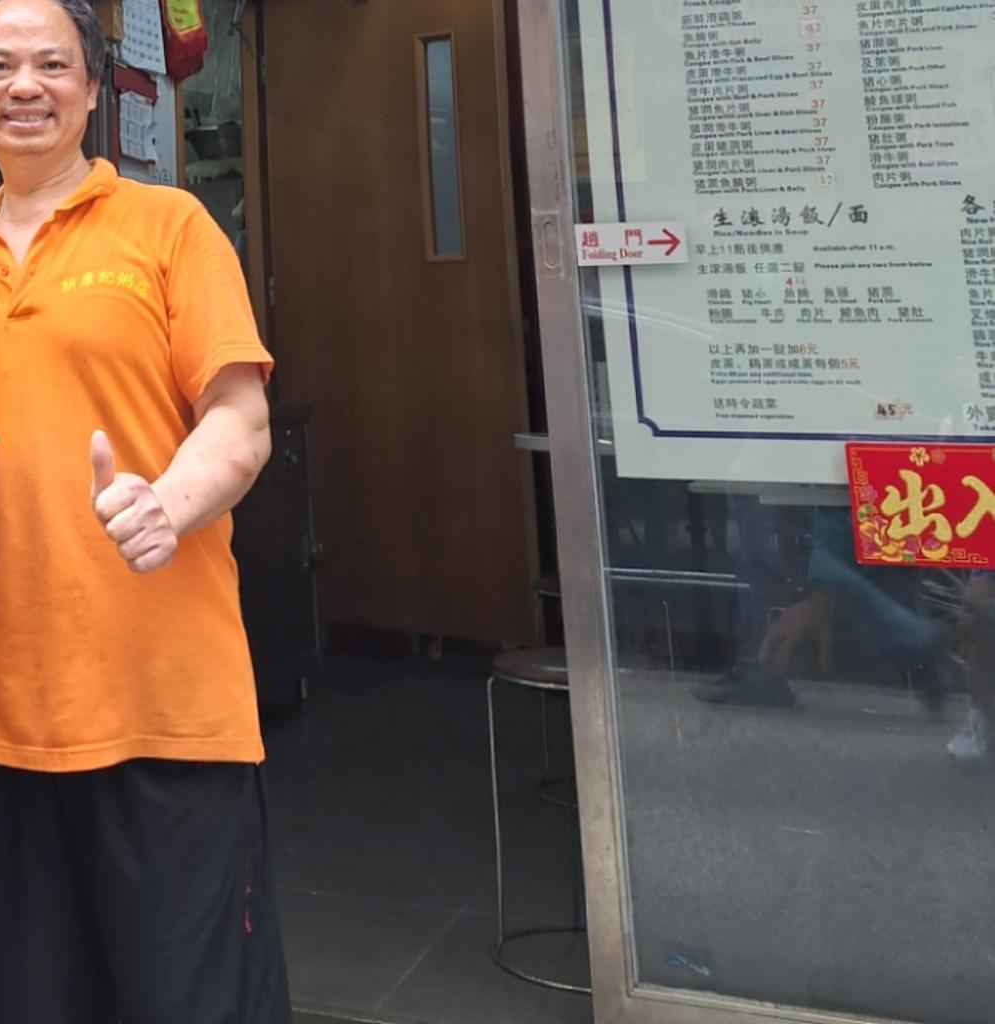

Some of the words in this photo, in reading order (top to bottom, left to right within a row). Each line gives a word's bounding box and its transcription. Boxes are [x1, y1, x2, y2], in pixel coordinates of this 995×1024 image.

[802, 5, 817, 15] 37
[806, 43, 820, 52] 37
[807, 62, 822, 71] 37
[810, 80, 824, 90] 37
[811, 99, 825, 109] 37
[812, 118, 827, 127] 37
[814, 137, 829, 146] 37
[816, 155, 831, 165] 37
[619, 247, 644, 259] Door
[879, 468, 995, 543] 出入
